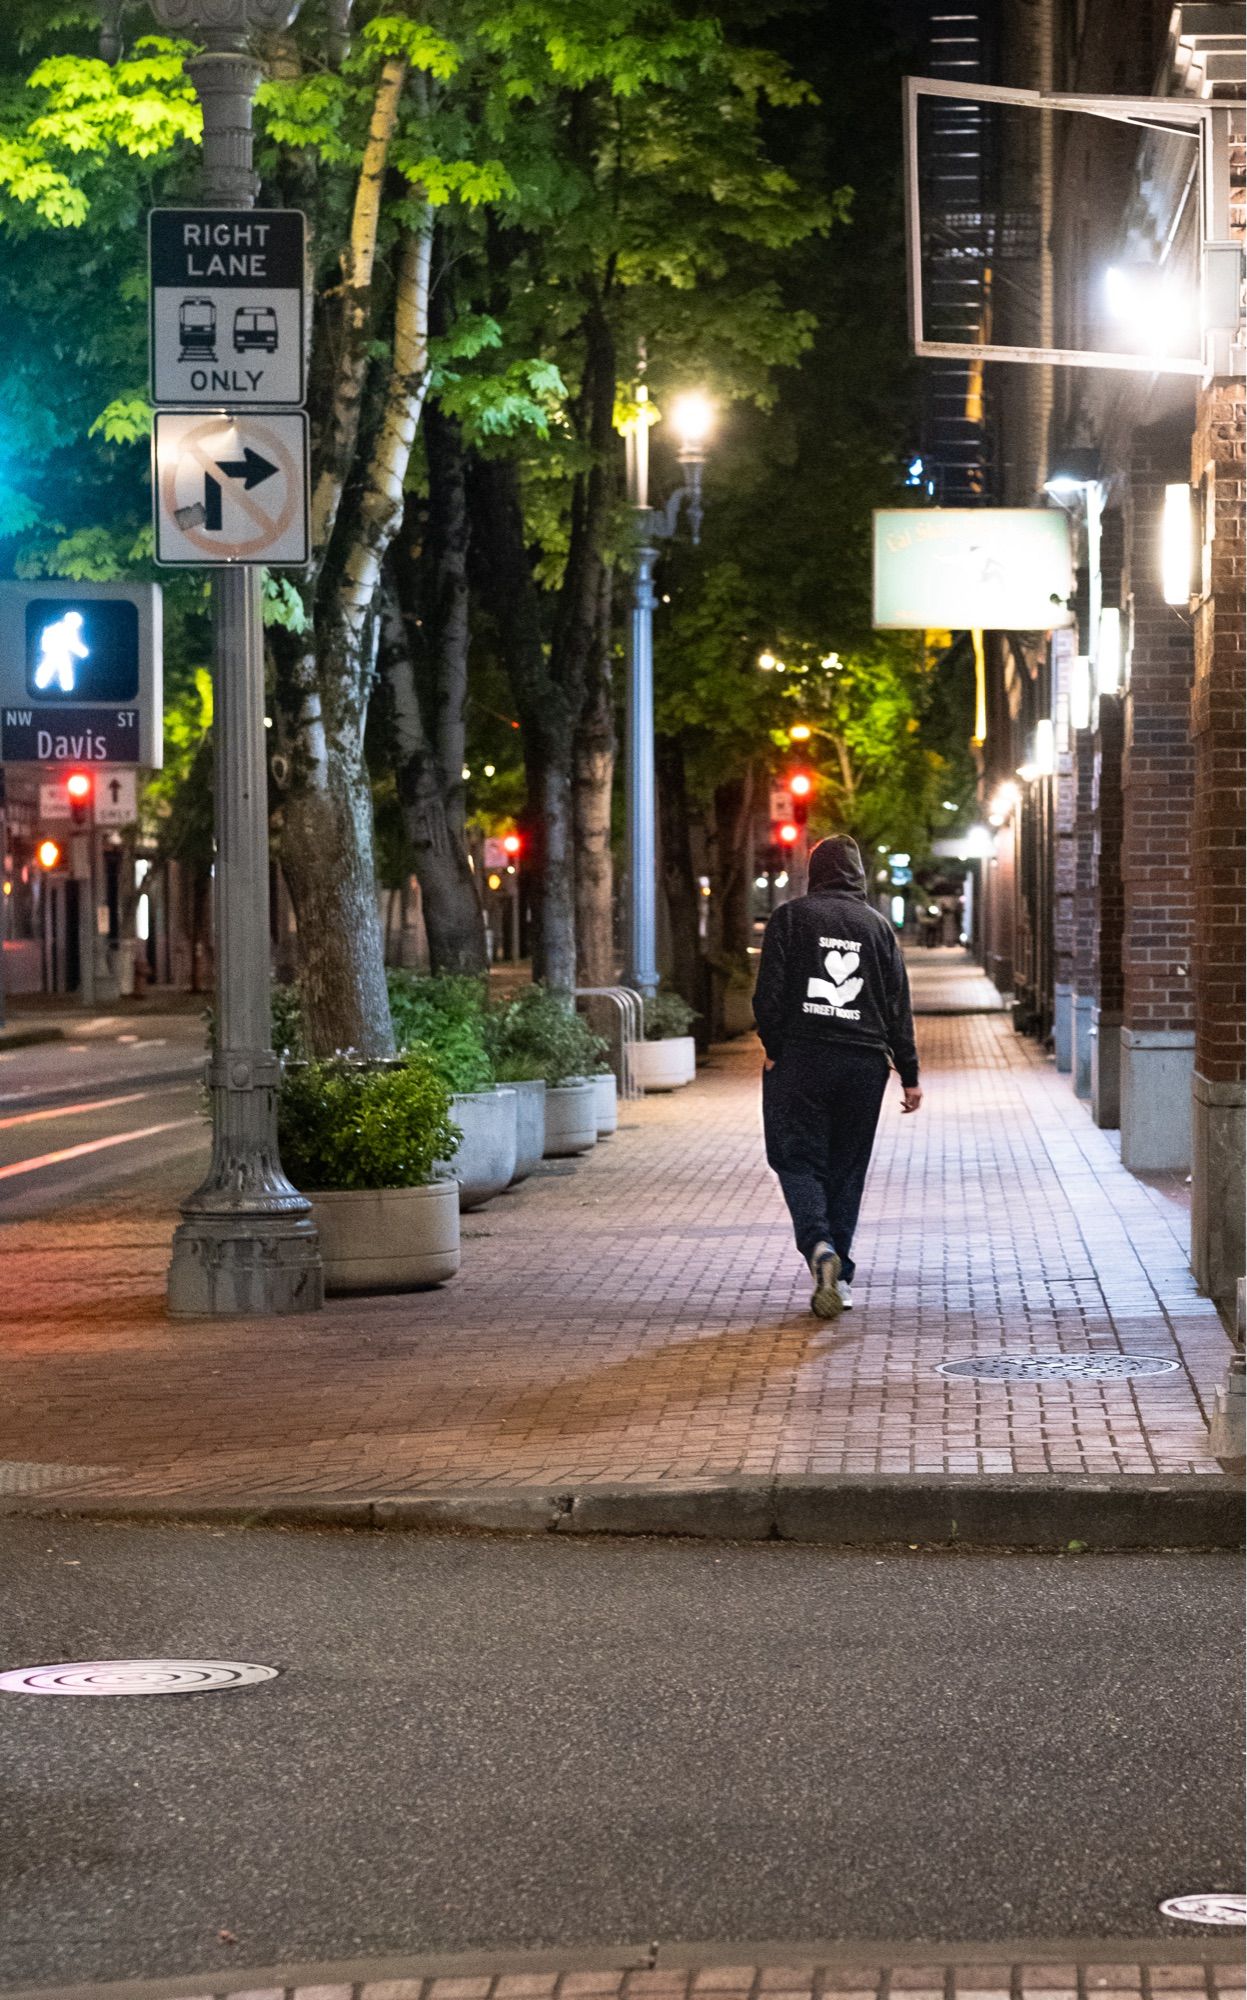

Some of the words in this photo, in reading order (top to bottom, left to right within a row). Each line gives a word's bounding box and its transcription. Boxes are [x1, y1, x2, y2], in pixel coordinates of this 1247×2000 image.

[183, 224, 270, 247] RIGHT
[187, 254, 267, 276] LANE
[190, 370, 264, 392] ONLY
[6, 711, 32, 726] NW
[117, 712, 135, 727] ST
[37, 729, 107, 759] Davis
[819, 936, 862, 952] SUPPORT
[802, 1002, 835, 1016] STREET
